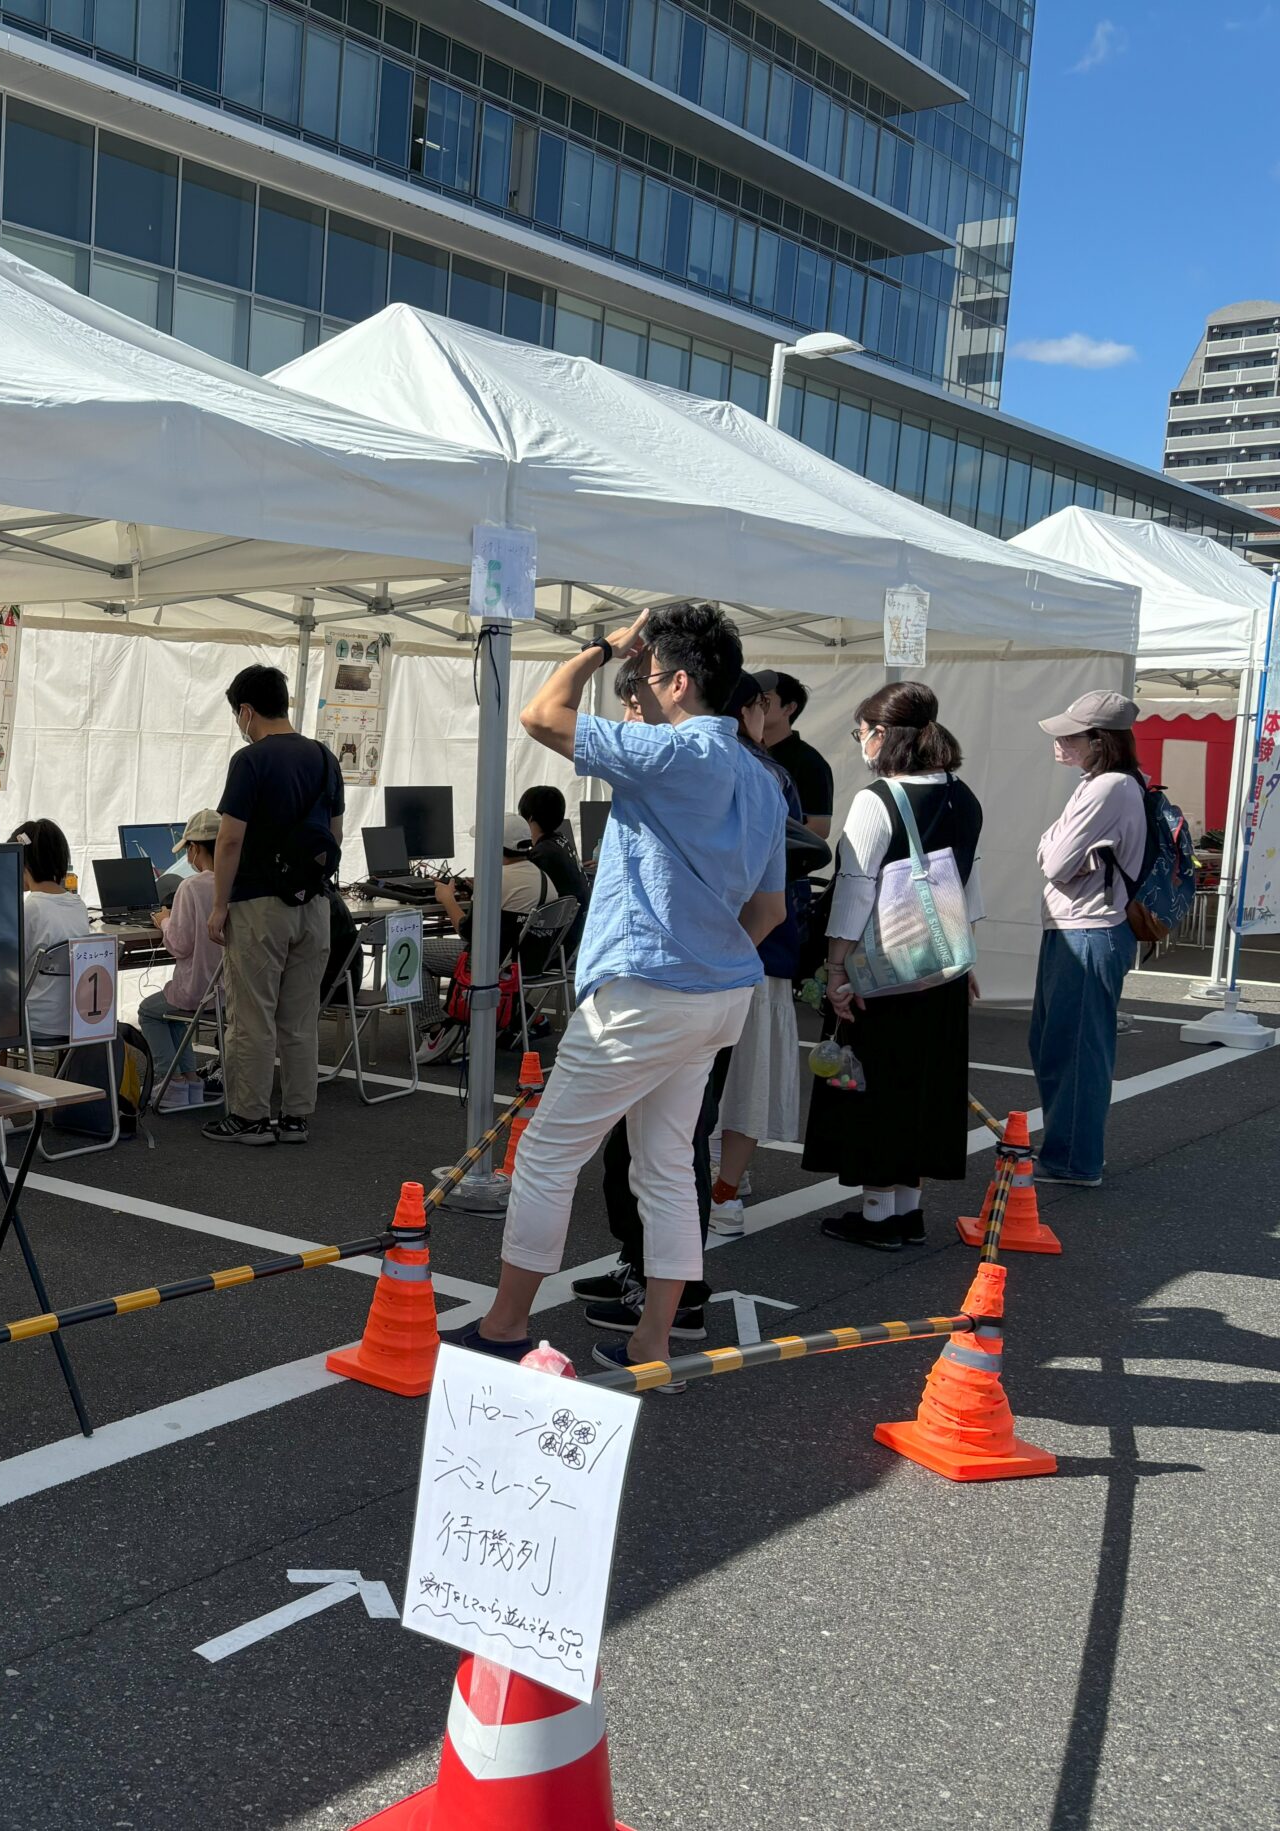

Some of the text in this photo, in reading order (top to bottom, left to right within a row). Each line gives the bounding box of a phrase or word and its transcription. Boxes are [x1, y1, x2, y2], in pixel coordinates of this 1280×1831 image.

[919, 885, 951, 963] HELLO SUNSHINE
[76, 950, 113, 960] シミュレーター
[397, 943, 411, 981] 2
[88, 972, 101, 1016] 1
